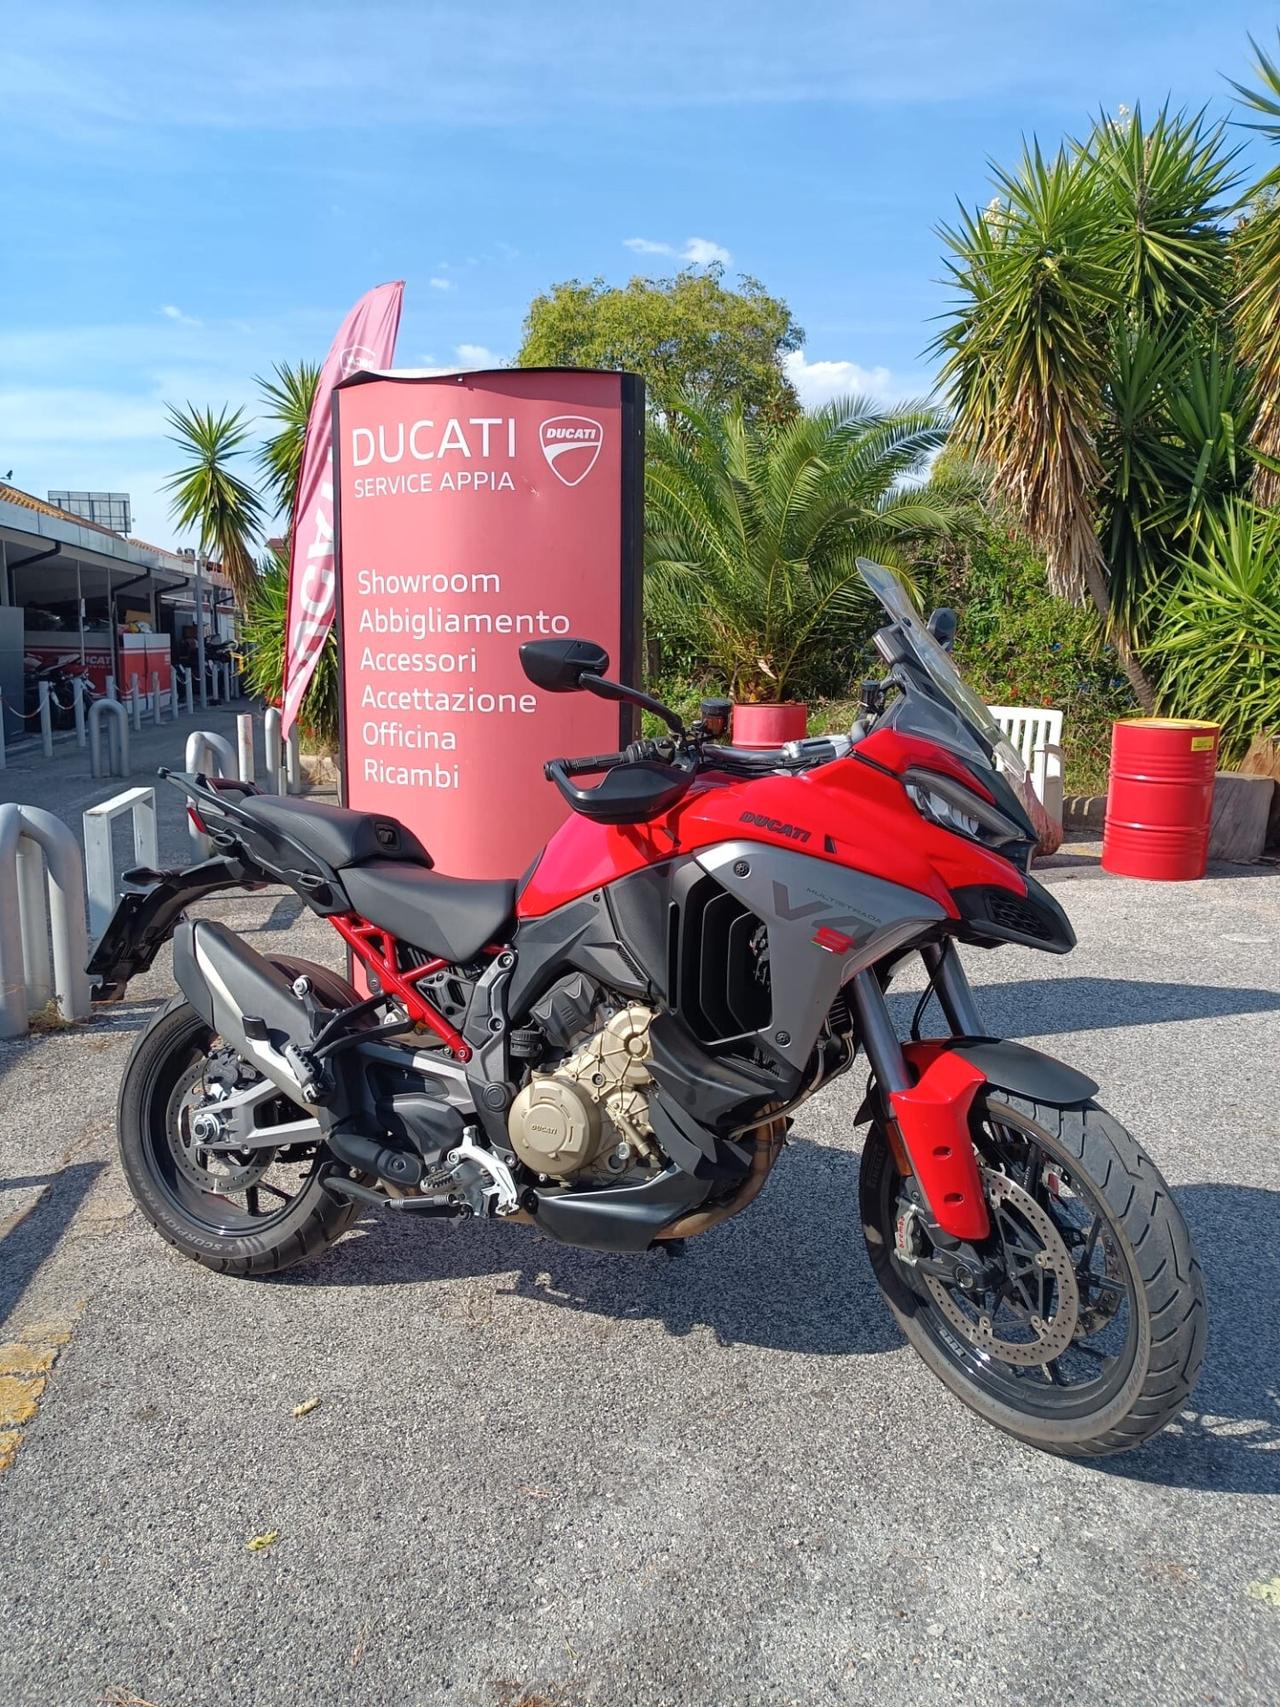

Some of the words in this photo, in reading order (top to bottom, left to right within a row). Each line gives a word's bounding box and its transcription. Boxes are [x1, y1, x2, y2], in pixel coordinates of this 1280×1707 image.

[352, 418, 516, 467] DUCATI
[546, 427, 597, 440] DUCATI
[354, 473, 433, 499] SERVICE
[439, 471, 516, 492] APPIA
[357, 569, 500, 595] Showroom
[358, 607, 570, 640] Abbigliamento
[359, 646, 477, 673] Accessori
[361, 684, 537, 713] Accettazione
[362, 721, 456, 750] Officina
[364, 758, 459, 789] Ricambi
[740, 811, 811, 843] DUCATI
[159, 1211, 223, 1252] SCORPION
